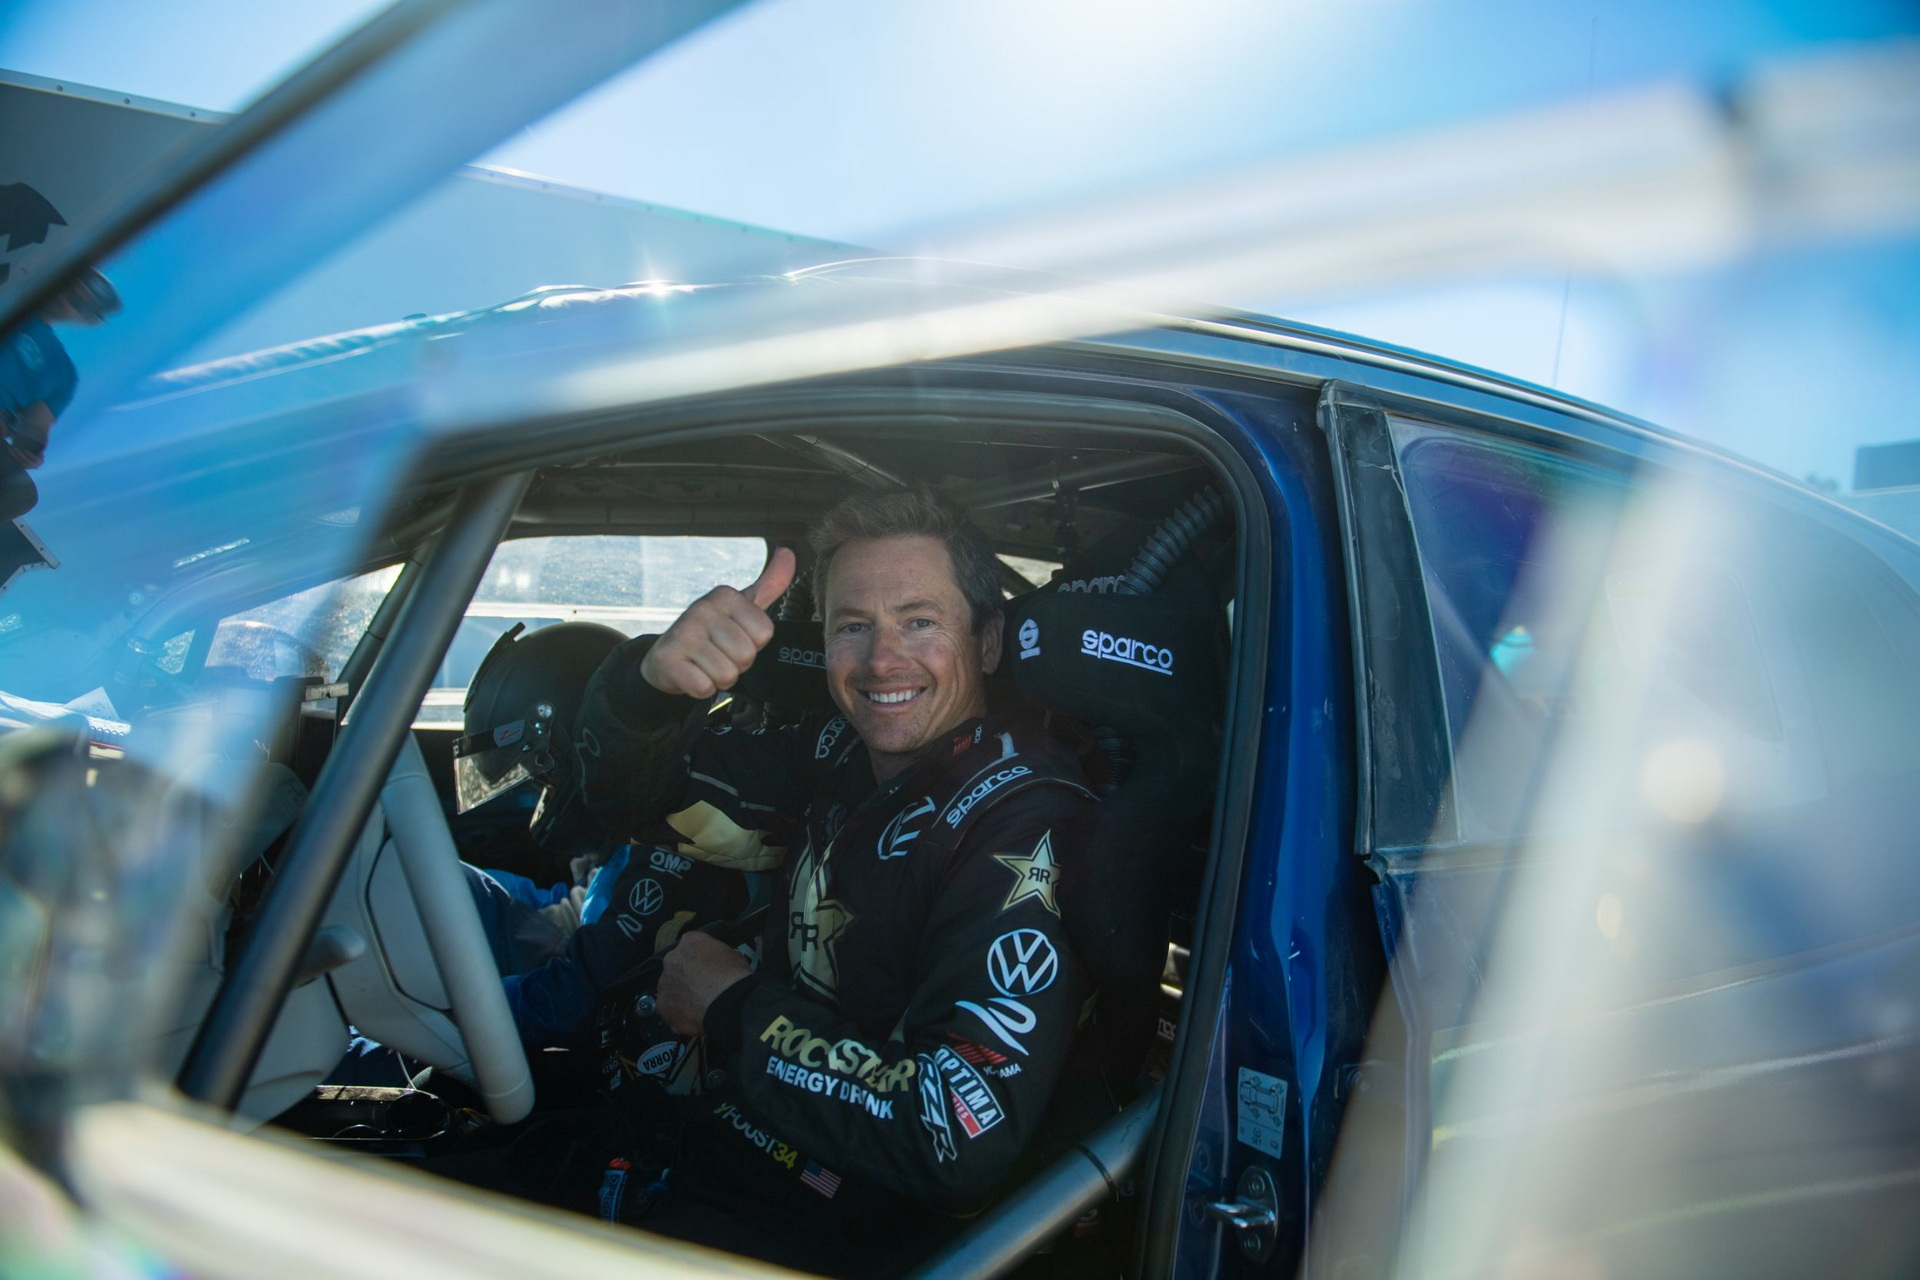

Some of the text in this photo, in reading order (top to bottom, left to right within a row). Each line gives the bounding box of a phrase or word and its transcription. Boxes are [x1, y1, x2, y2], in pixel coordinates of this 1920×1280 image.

[1081, 630, 1173, 673] sparco
[946, 766, 1031, 828] sparco
[650, 850, 693, 872] OMP
[766, 1056, 894, 1119] ENERGY DRINK
[934, 1048, 998, 1125] OPTIMA
